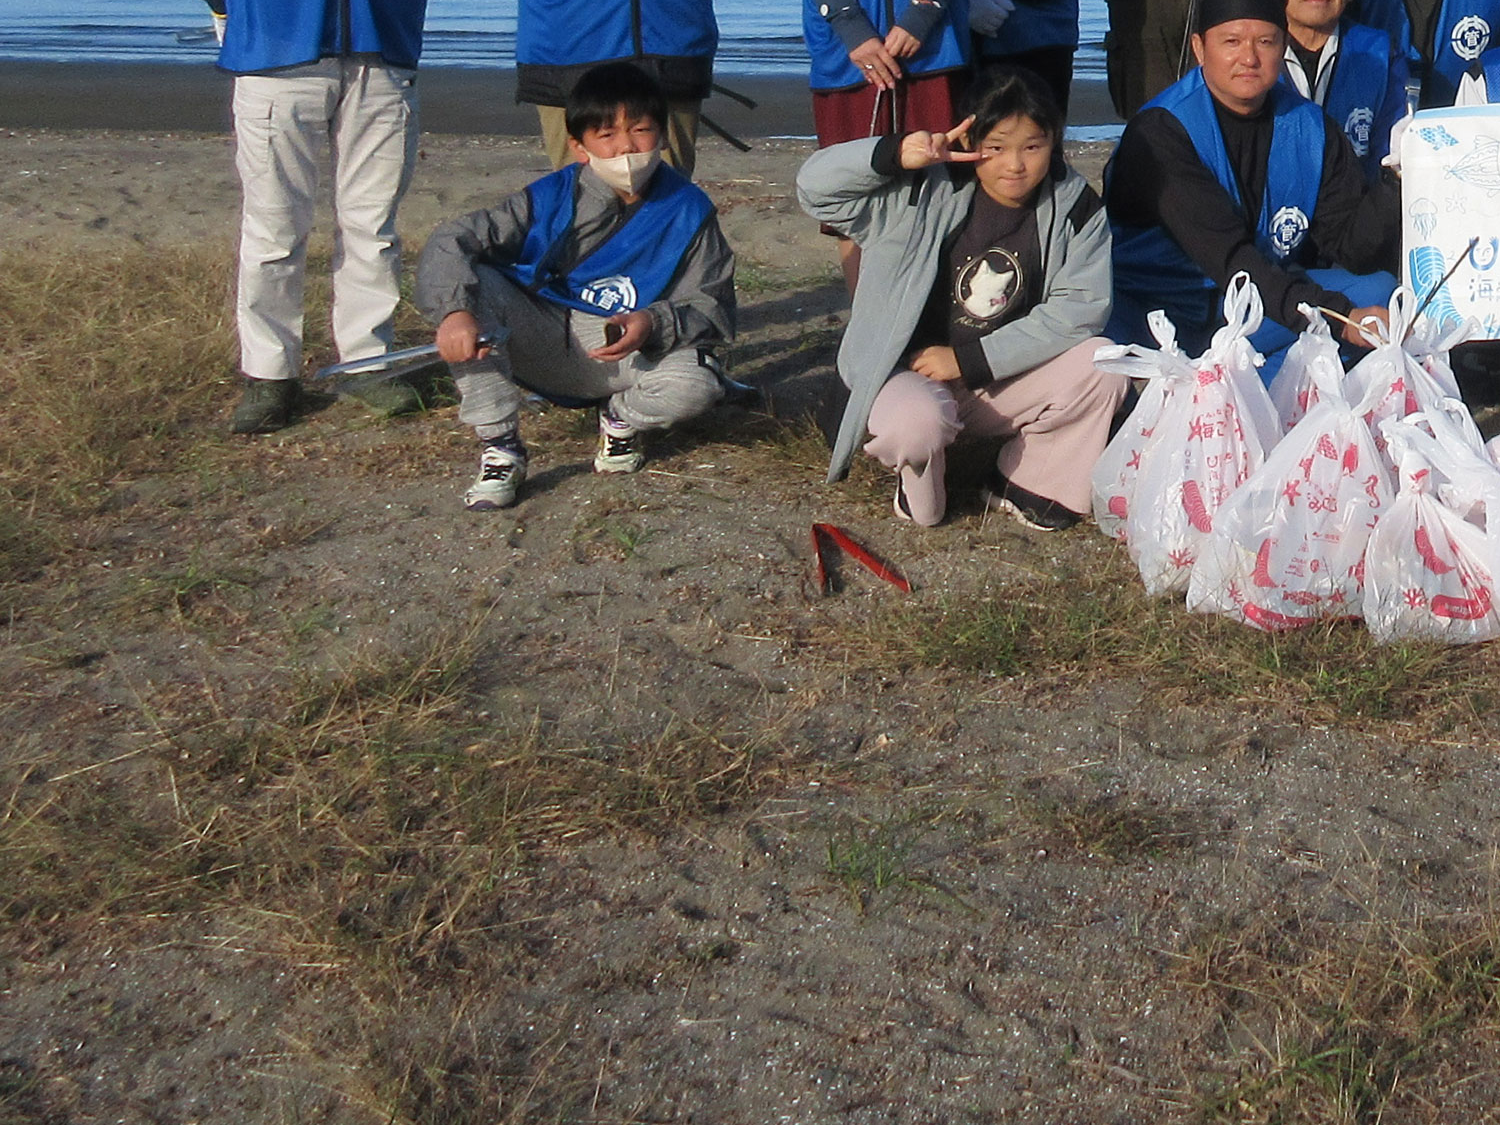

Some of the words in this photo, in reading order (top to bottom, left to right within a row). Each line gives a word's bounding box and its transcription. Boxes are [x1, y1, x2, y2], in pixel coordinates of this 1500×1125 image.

[1464, 29, 1480, 47] 管
[1279, 223, 1297, 242] 管
[597, 287, 622, 311] 管
